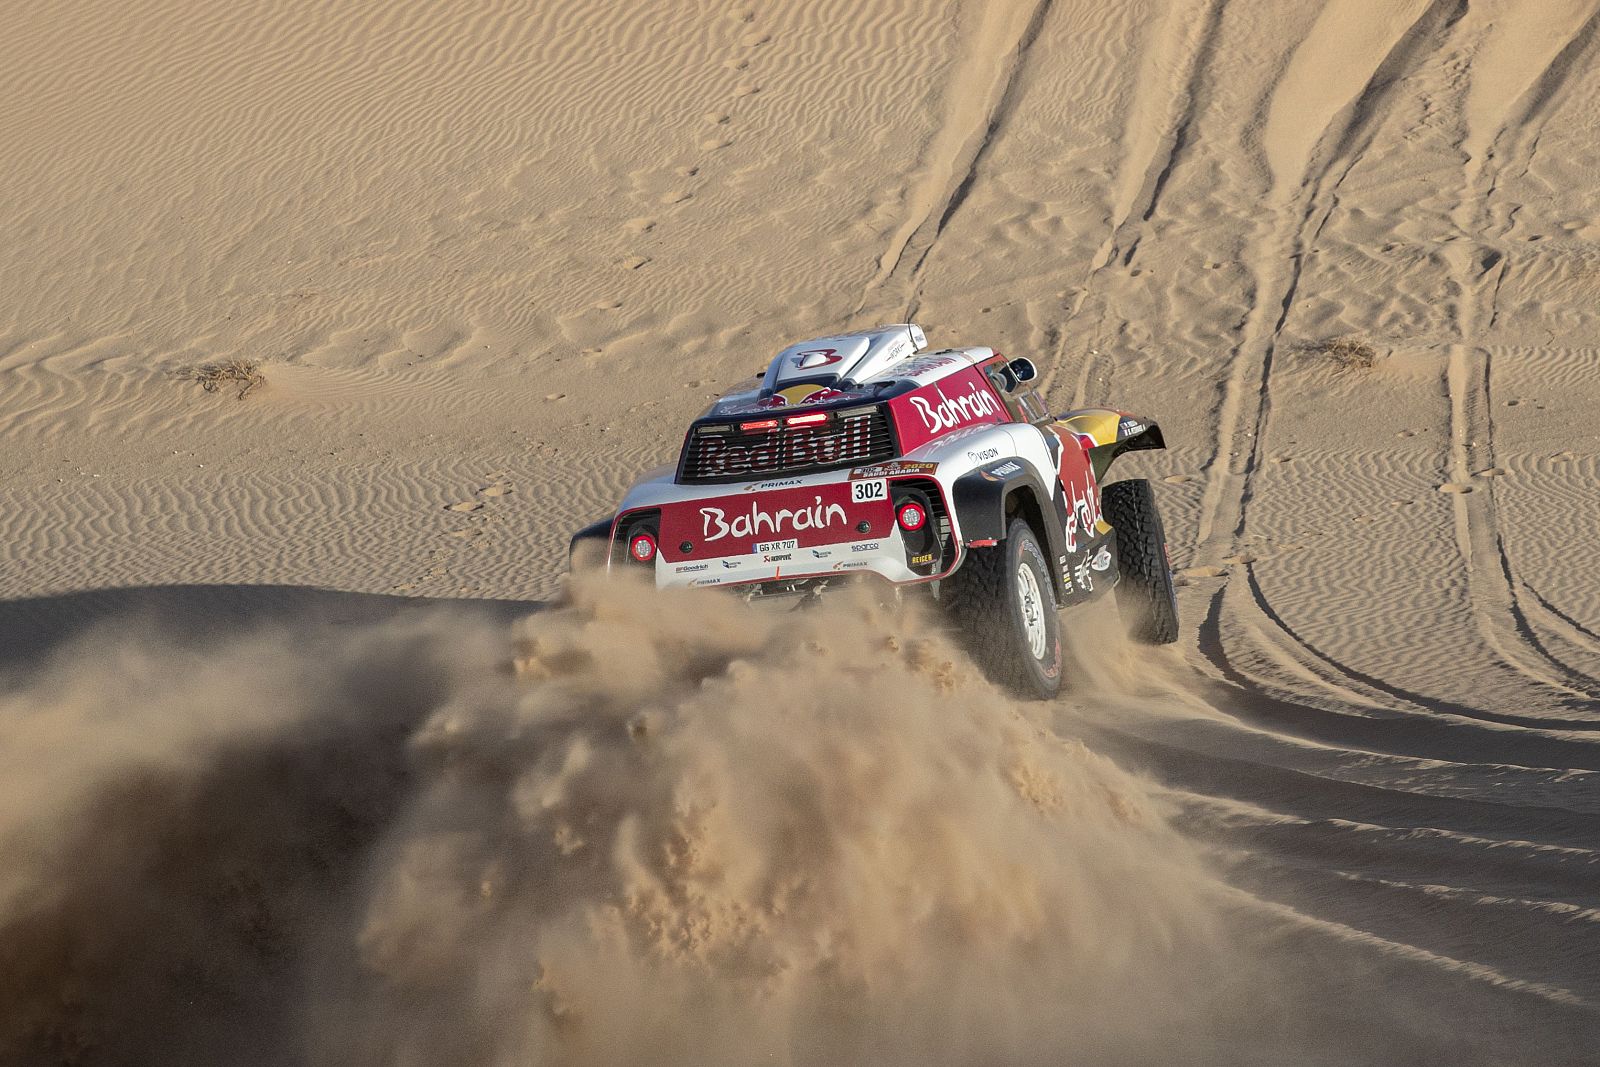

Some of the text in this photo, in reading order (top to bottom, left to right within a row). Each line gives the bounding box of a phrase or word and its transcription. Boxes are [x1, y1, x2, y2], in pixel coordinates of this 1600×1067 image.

[909, 382, 1001, 434] Bahrain
[977, 448, 999, 460] VISION
[862, 468, 920, 478] SAUDI ARABIA
[760, 479, 803, 489] PRIMAX
[855, 482, 883, 500] 302
[699, 495, 848, 541] Bahrain
[759, 540, 796, 552] GG XR 707
[851, 542, 880, 552] sparco
